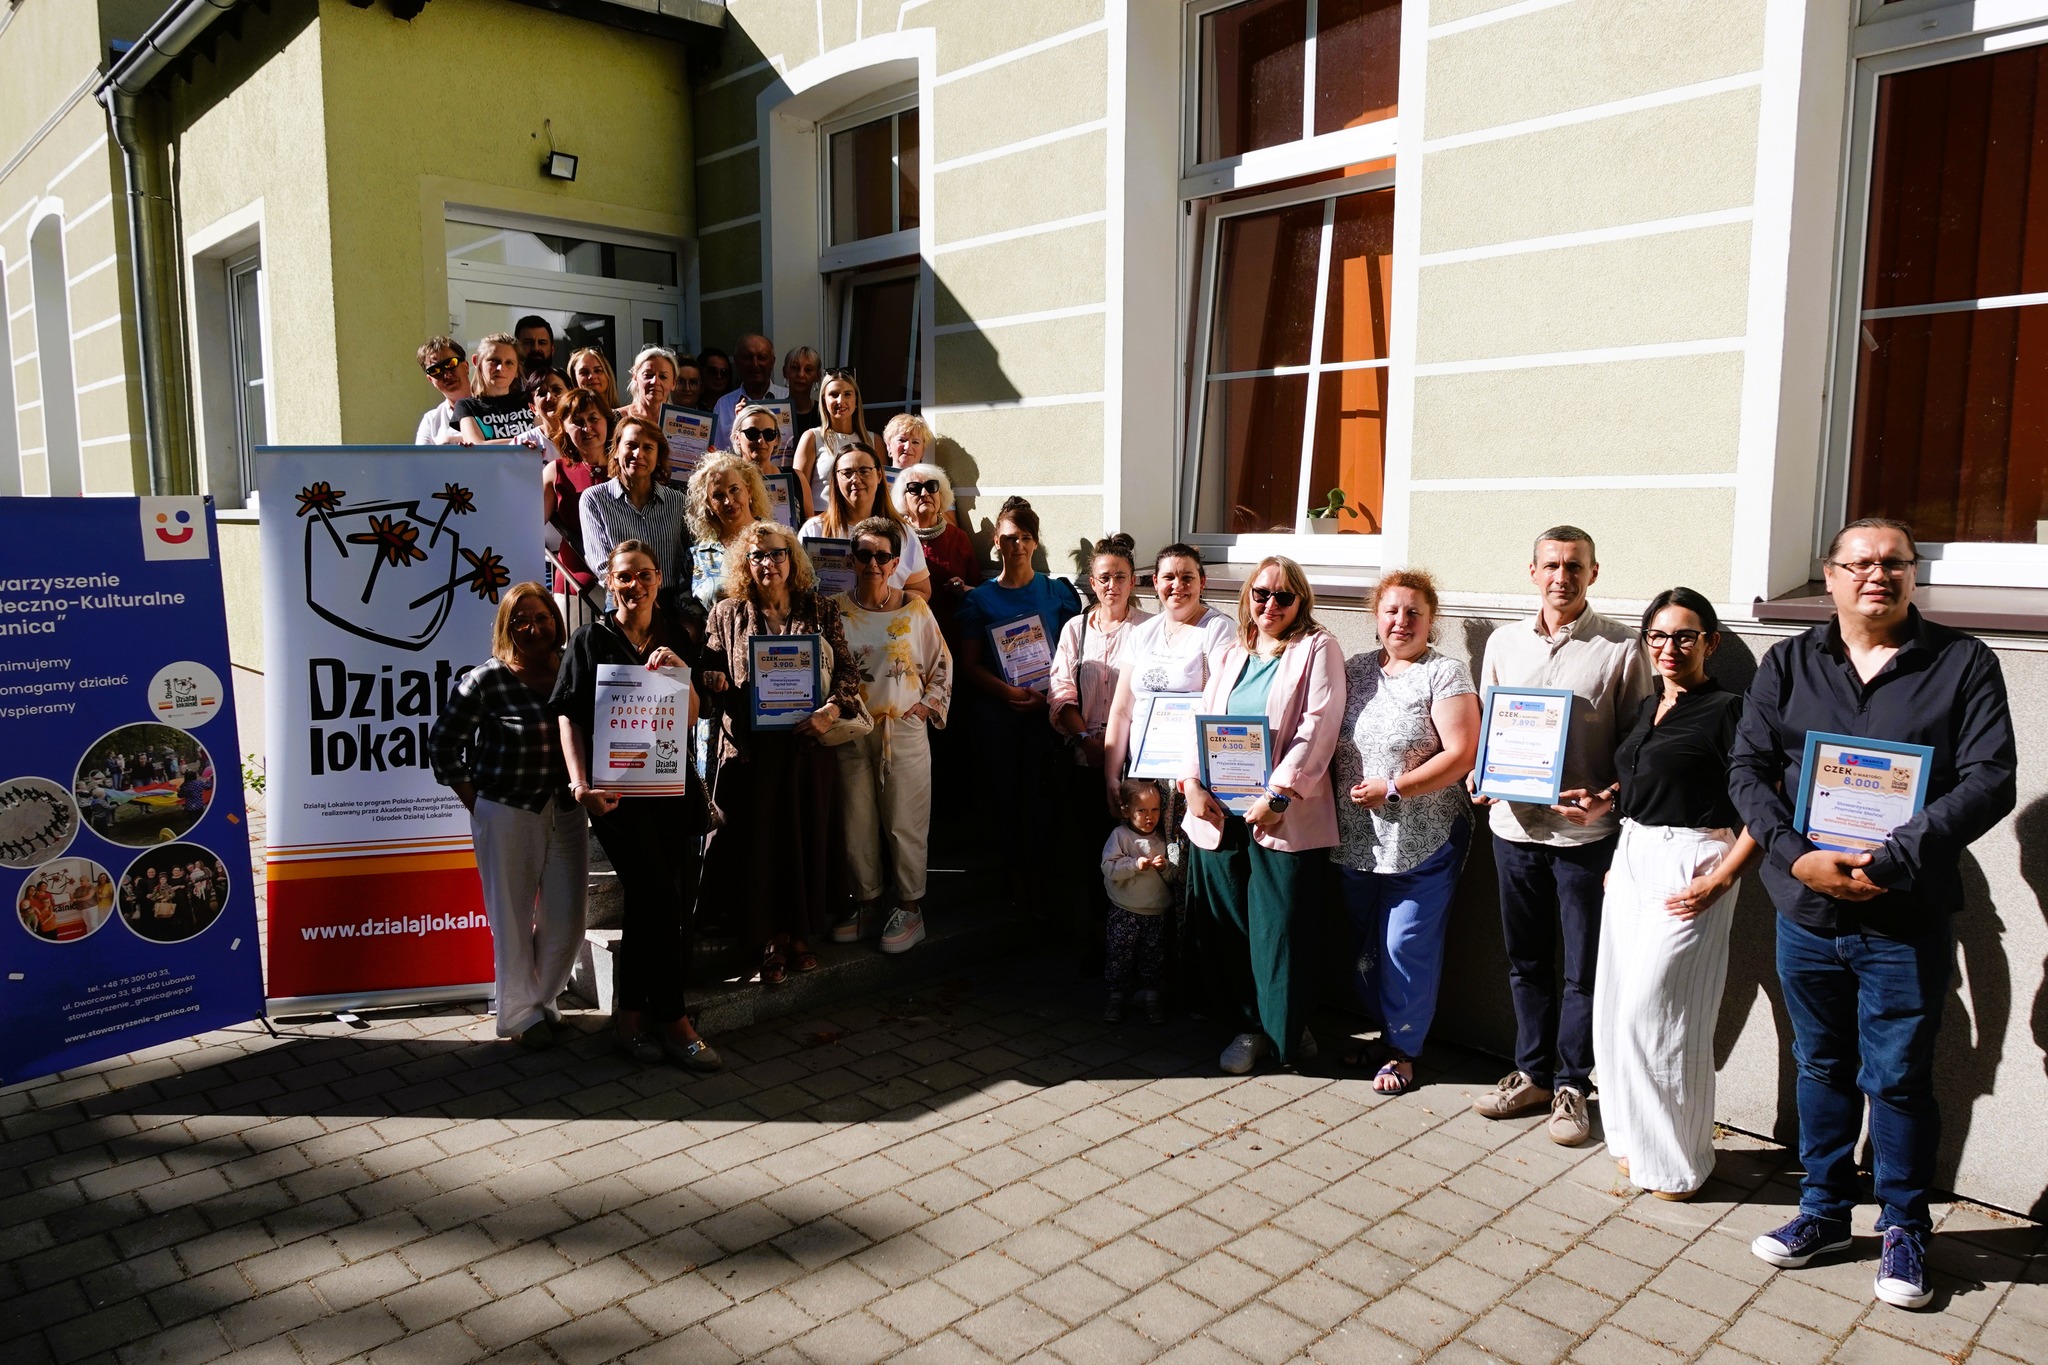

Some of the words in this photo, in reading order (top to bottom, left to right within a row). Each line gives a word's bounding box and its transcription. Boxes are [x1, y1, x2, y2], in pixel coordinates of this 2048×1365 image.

[483, 408, 534, 425] otwarte
[493, 420, 535, 439] klatk
[79, 674, 129, 689] działać
[309, 657, 476, 722] Dział
[611, 694, 675, 704] wyzwolisz
[610, 718, 675, 732] energię
[1512, 718, 1536, 727] 7.890
[310, 722, 430, 775] lokal
[655, 759, 678, 769] Działaj
[1823, 764, 1853, 775] CZEK
[1843, 776, 1880, 790] 8.000
[303, 801, 327, 810] Działaj
[327, 799, 356, 808] Lokalnie
[356, 799, 364, 807] to
[364, 799, 391, 809] program
[321, 808, 361, 817] realizowany
[361, 807, 380, 815] przez
[380, 805, 411, 815] Akademię
[412, 804, 440, 813] Rozwoju
[372, 814, 375, 822] i
[375, 813, 403, 822] Ośrodek
[403, 811, 426, 821] Działaj
[426, 811, 453, 819] Lokalnie
[87, 985, 100, 993] tel.
[102, 979, 118, 989] +48
[119, 977, 130, 986] 75
[130, 974, 146, 983] 300
[147, 971, 158, 979] 00
[159, 968, 171, 977] 33,
[62, 1003, 73, 1011] ul.
[74, 993, 117, 1008] Dworcowa
[118, 989, 131, 997] 33,
[131, 981, 160, 994] 58-420
[161, 973, 196, 987] Lubawka
[67, 985, 193, 1021] stowarzyszenie_granica@wp.pl
[64, 1004, 200, 1043] www.stowarzyszenie-granica.org
